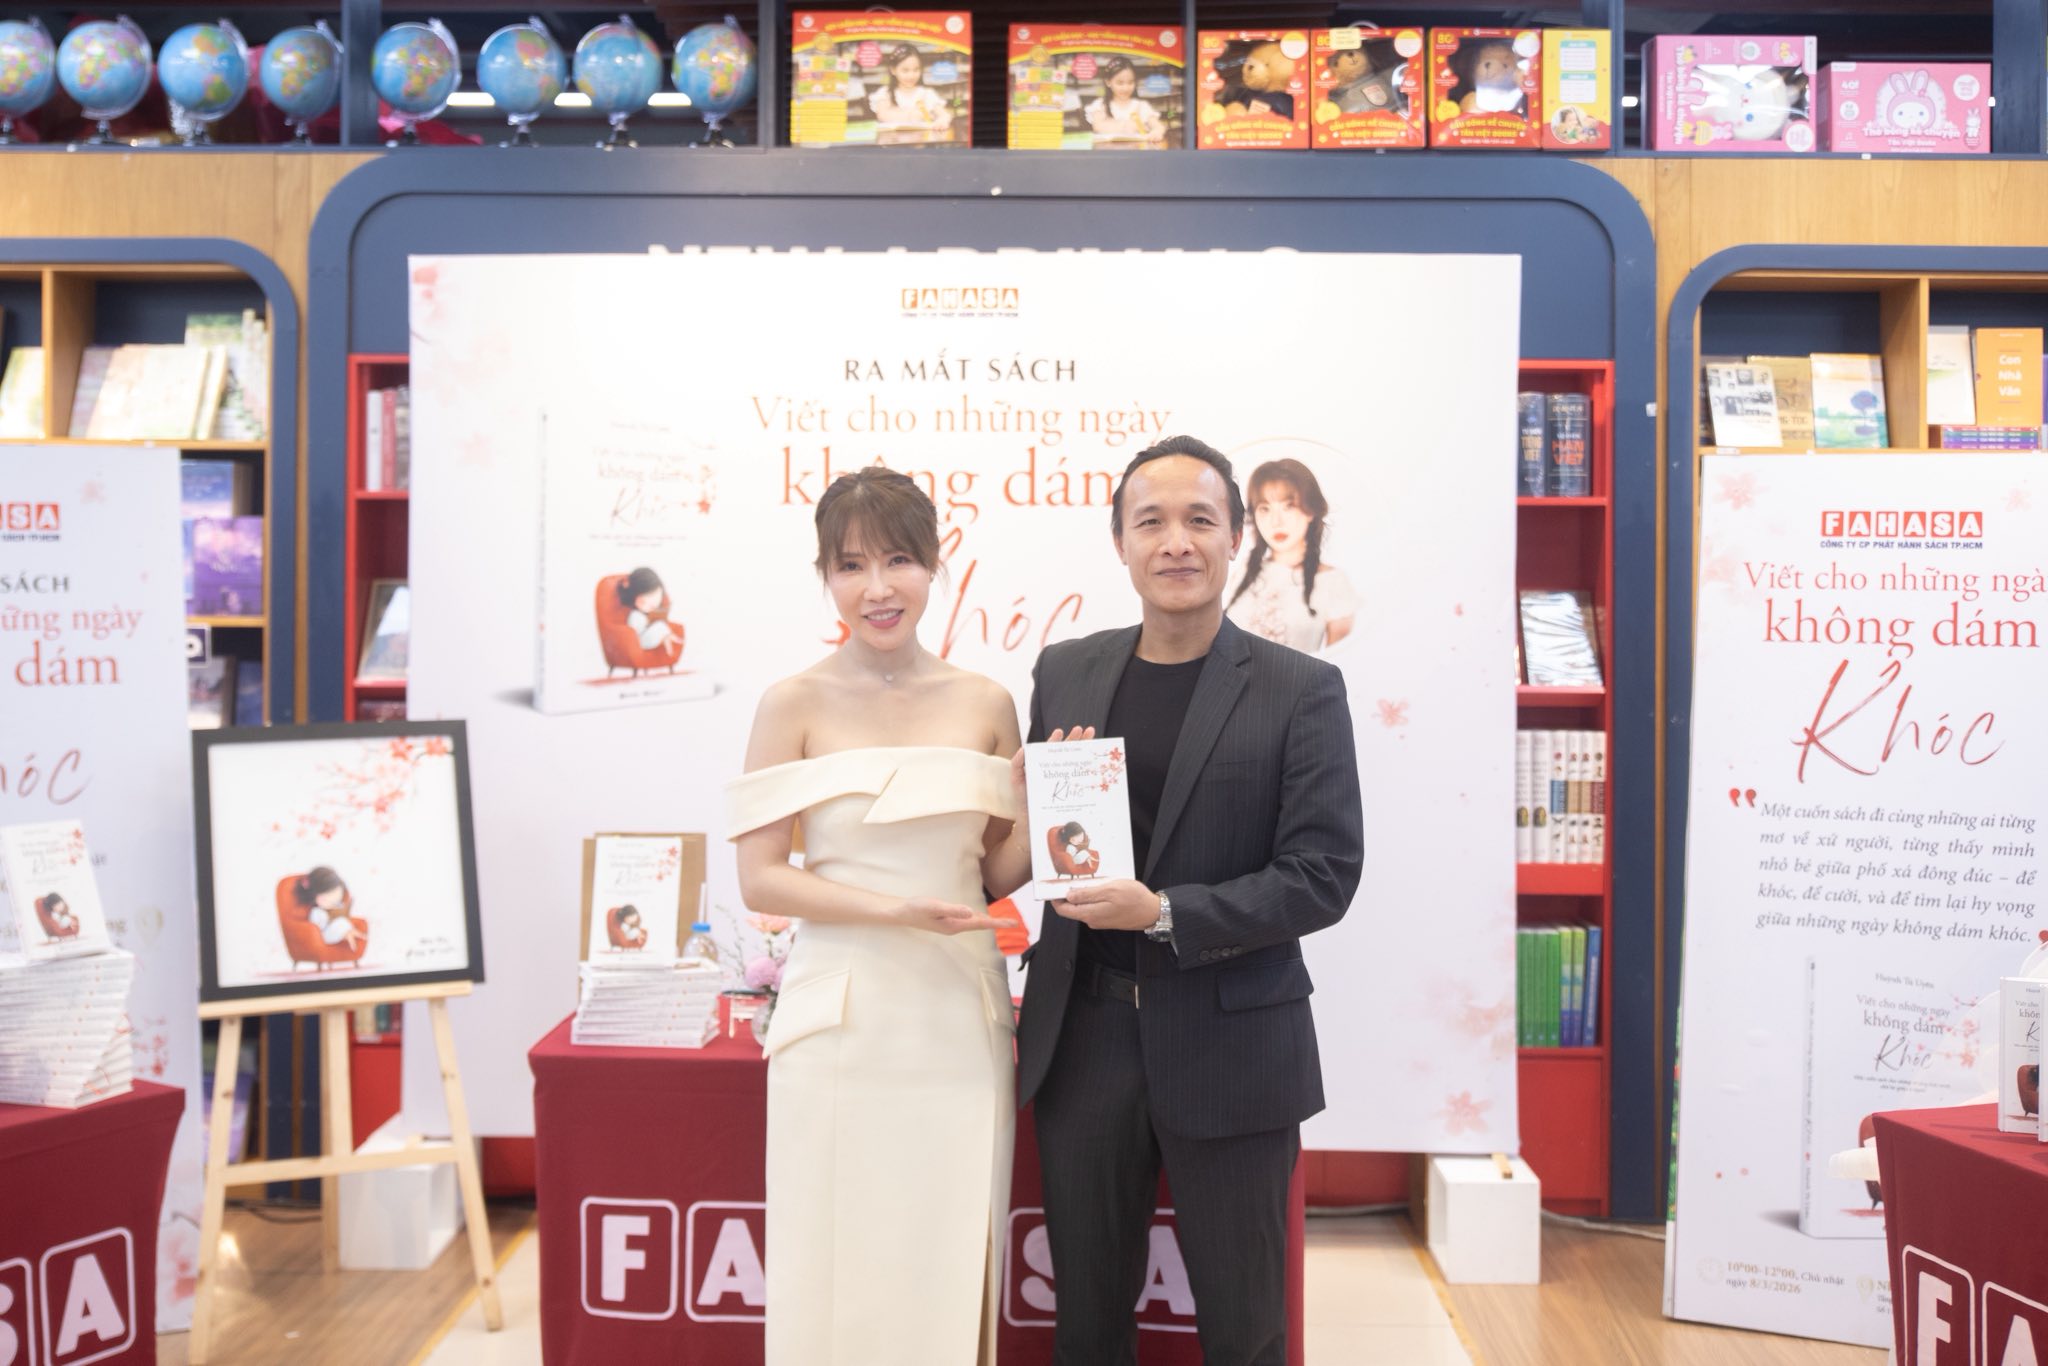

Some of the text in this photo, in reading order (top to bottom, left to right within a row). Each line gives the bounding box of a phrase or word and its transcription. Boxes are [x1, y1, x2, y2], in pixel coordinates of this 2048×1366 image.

[902, 288, 1018, 309] FAHASA
[845, 348, 1076, 383] RA MẮT SÁCH
[752, 395, 1172, 447] Viết cho những ngày
[1821, 511, 1983, 538] FAHASA
[1820, 540, 1843, 549] CÔNG
[1846, 541, 1856, 549] TY
[1859, 541, 1870, 549] CP
[1873, 540, 1895, 549] PHÁT
[1897, 540, 1922, 549] HÀNH
[1925, 540, 1948, 549] SÁCH
[1744, 561, 2048, 602] Viết cho những ngà
[72, 603, 142, 640] ngày
[1762, 598, 2040, 658] không dám
[15, 640, 121, 686] dám
[1790, 659, 2005, 783] Khóc
[1761, 802, 2036, 834] Một cuốn sách đi cùng những ai từng
[1760, 832, 1784, 844] mơ
[1816, 833, 1838, 846] xứ
[1845, 835, 1893, 853] người,
[1903, 837, 1939, 856] từng
[1948, 838, 1983, 858] thấy
[1992, 842, 2035, 857] mình
[1759, 856, 1788, 871] nhỏ
[1794, 857, 1812, 872] bé
[1815, 860, 1851, 878] giữa
[1856, 861, 1887, 880] phố
[1891, 864, 1911, 878] xá
[1918, 865, 1957, 885] đông
[1963, 867, 1993, 883] đúc
[2016, 869, 2038, 885] để
[1758, 883, 2035, 919] khóc, để cười, và để tìm lại hy vọng
[1755, 911, 2031, 942] giữa những ngày không dám khóc.
[1878, 998, 1896, 1009] cho
[2019, 1008, 2040, 1018] khôn
[1864, 1008, 1944, 1035] không dám
[1874, 1034, 1933, 1072] Khóc
